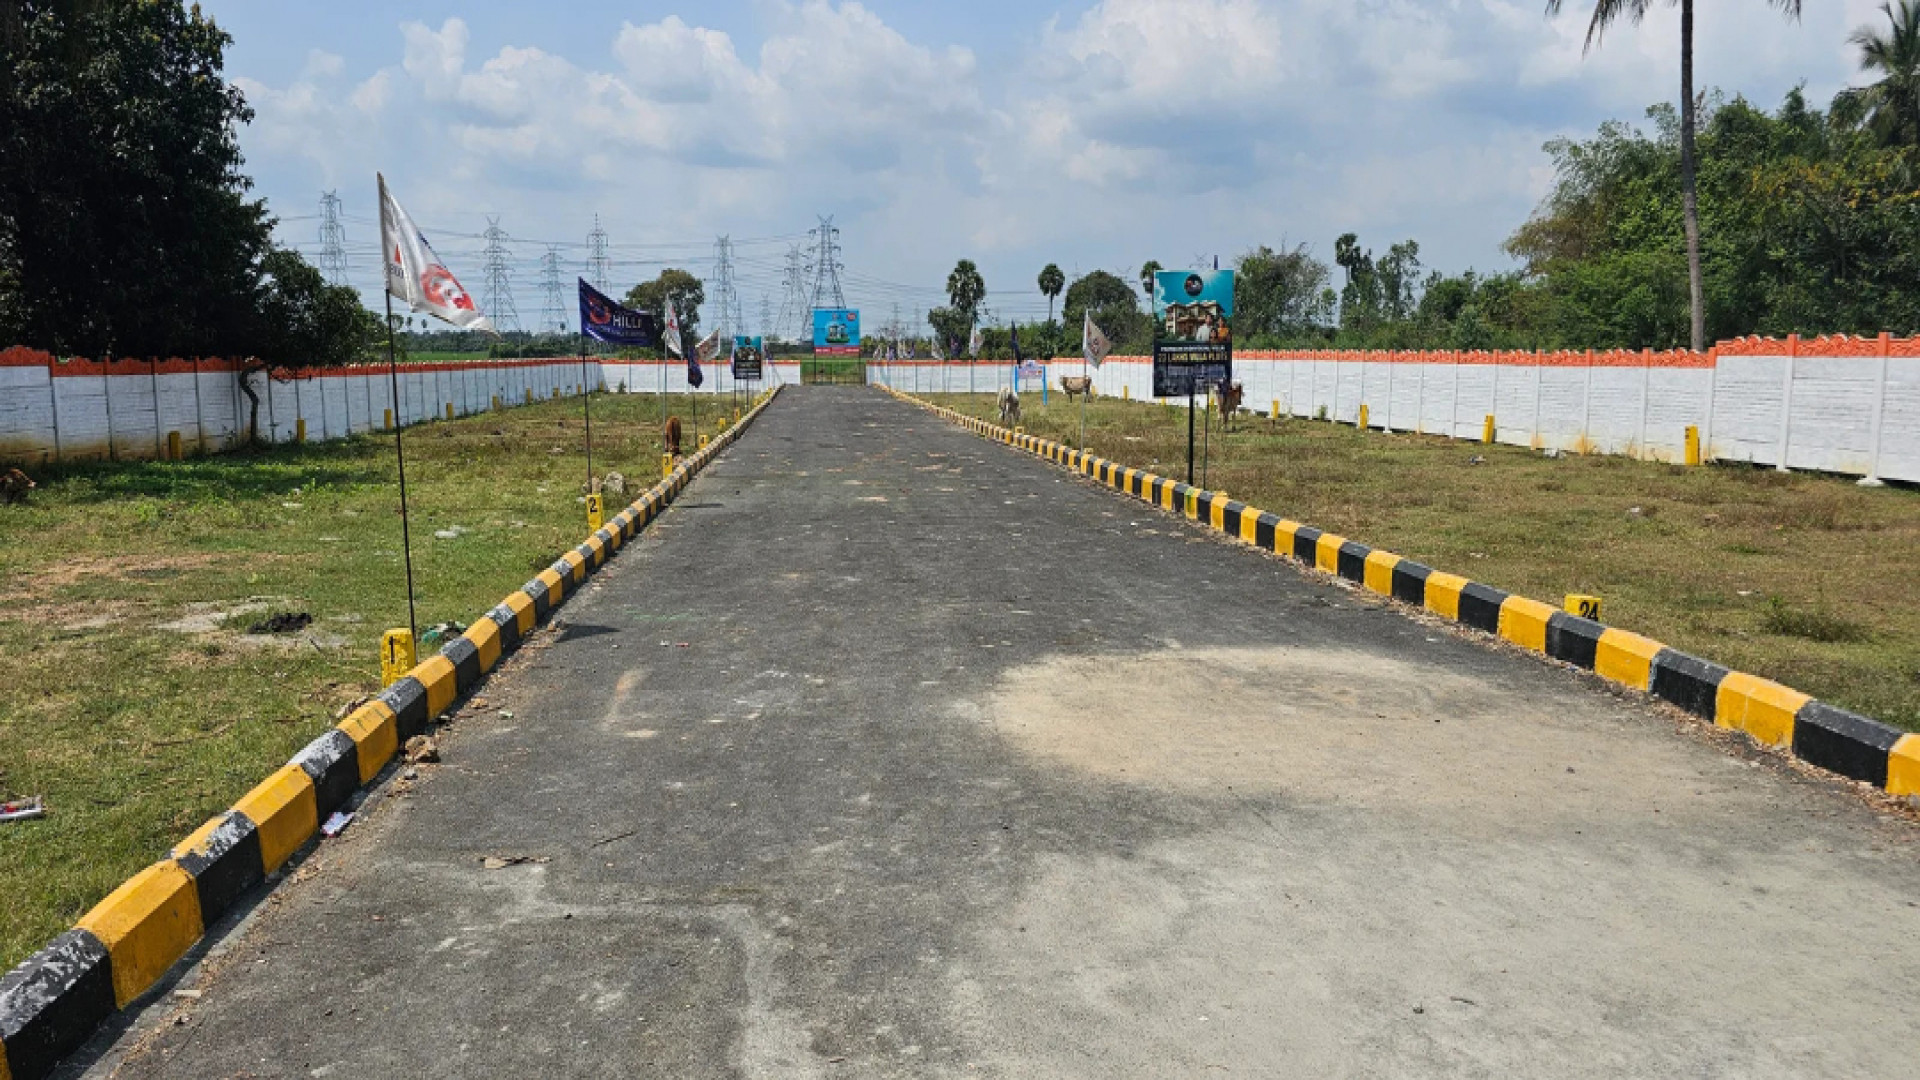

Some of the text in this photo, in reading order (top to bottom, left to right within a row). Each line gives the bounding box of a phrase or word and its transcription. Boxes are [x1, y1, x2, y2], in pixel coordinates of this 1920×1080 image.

[588, 497, 598, 513] 2
[1580, 601, 1598, 621] 24
[388, 635, 396, 665] 1
